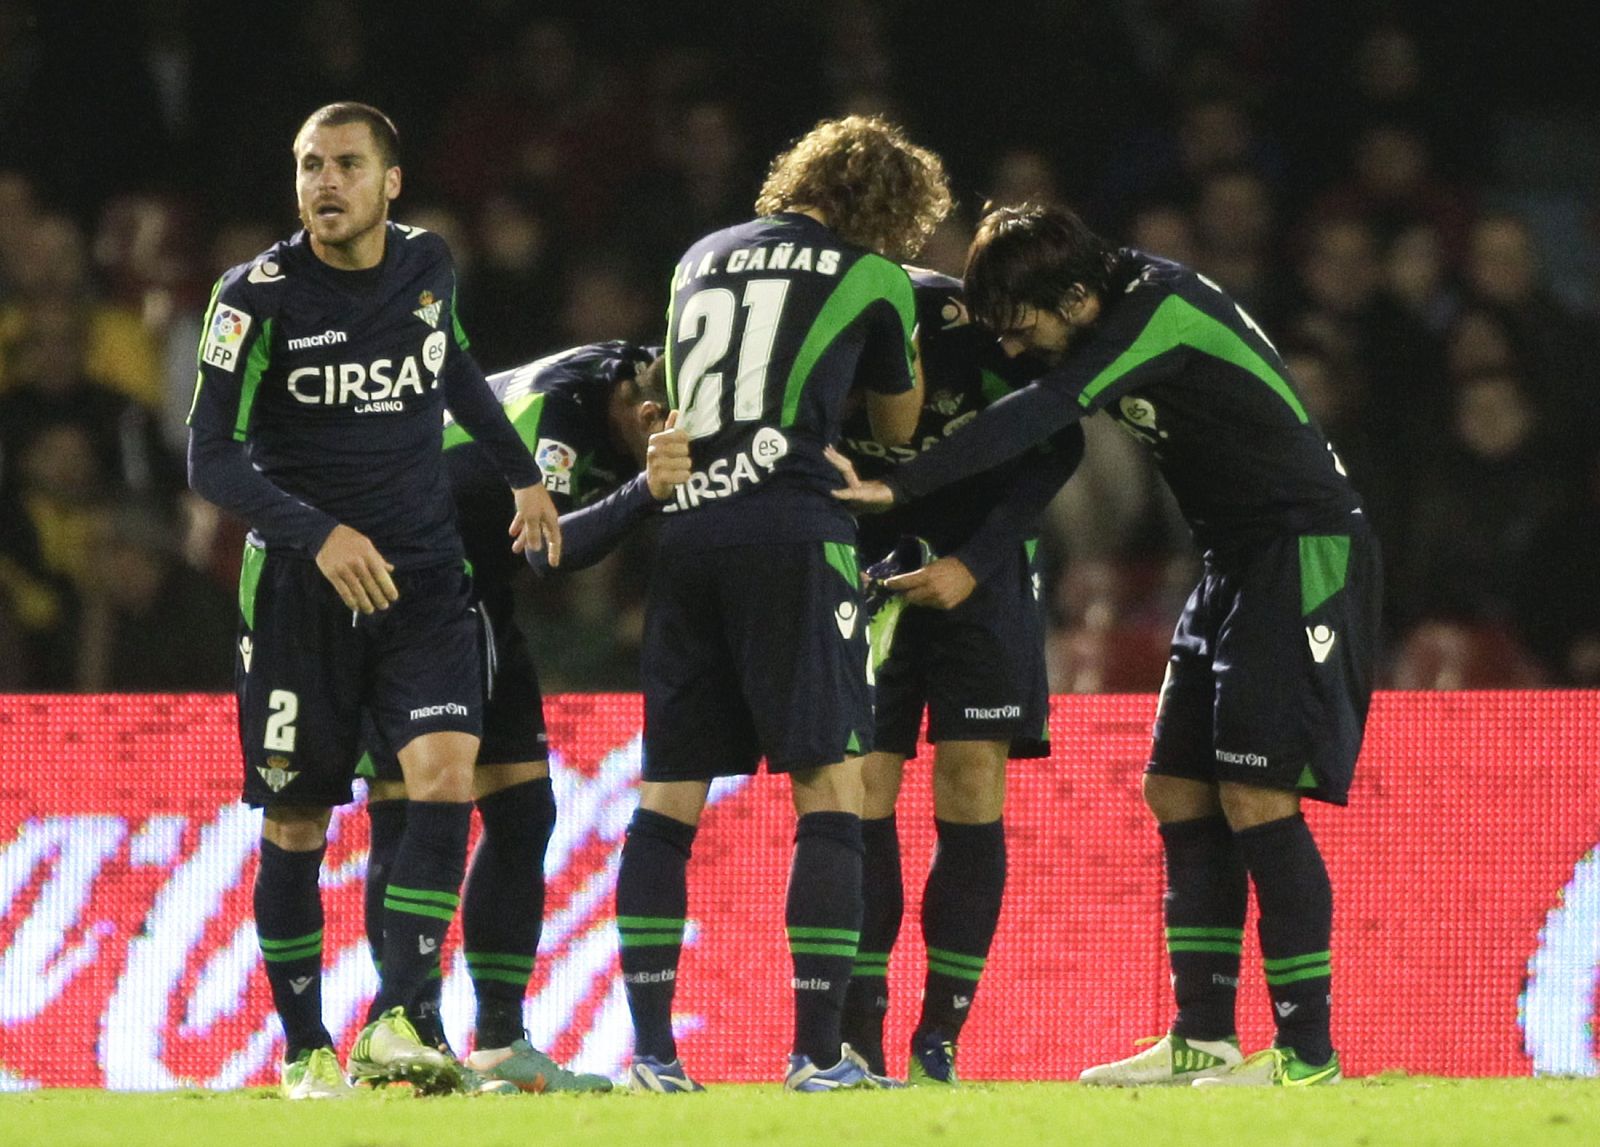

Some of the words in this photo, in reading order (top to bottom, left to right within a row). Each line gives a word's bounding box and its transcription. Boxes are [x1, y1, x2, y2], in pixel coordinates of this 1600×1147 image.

[675, 261, 692, 291] J.
[695, 250, 718, 279] A.
[726, 242, 841, 276] CAÑAS
[287, 330, 347, 350] macron
[205, 342, 232, 366] LFP
[428, 342, 443, 361] es
[676, 279, 791, 441] 21
[287, 356, 424, 405] CIRSA
[354, 400, 403, 414] CASINO
[758, 439, 780, 456] es
[543, 474, 567, 491] FP
[662, 452, 760, 513] IRSA
[263, 689, 298, 752] 2
[410, 702, 467, 720] macron
[964, 704, 1020, 720] macron
[1215, 749, 1268, 768] macron
